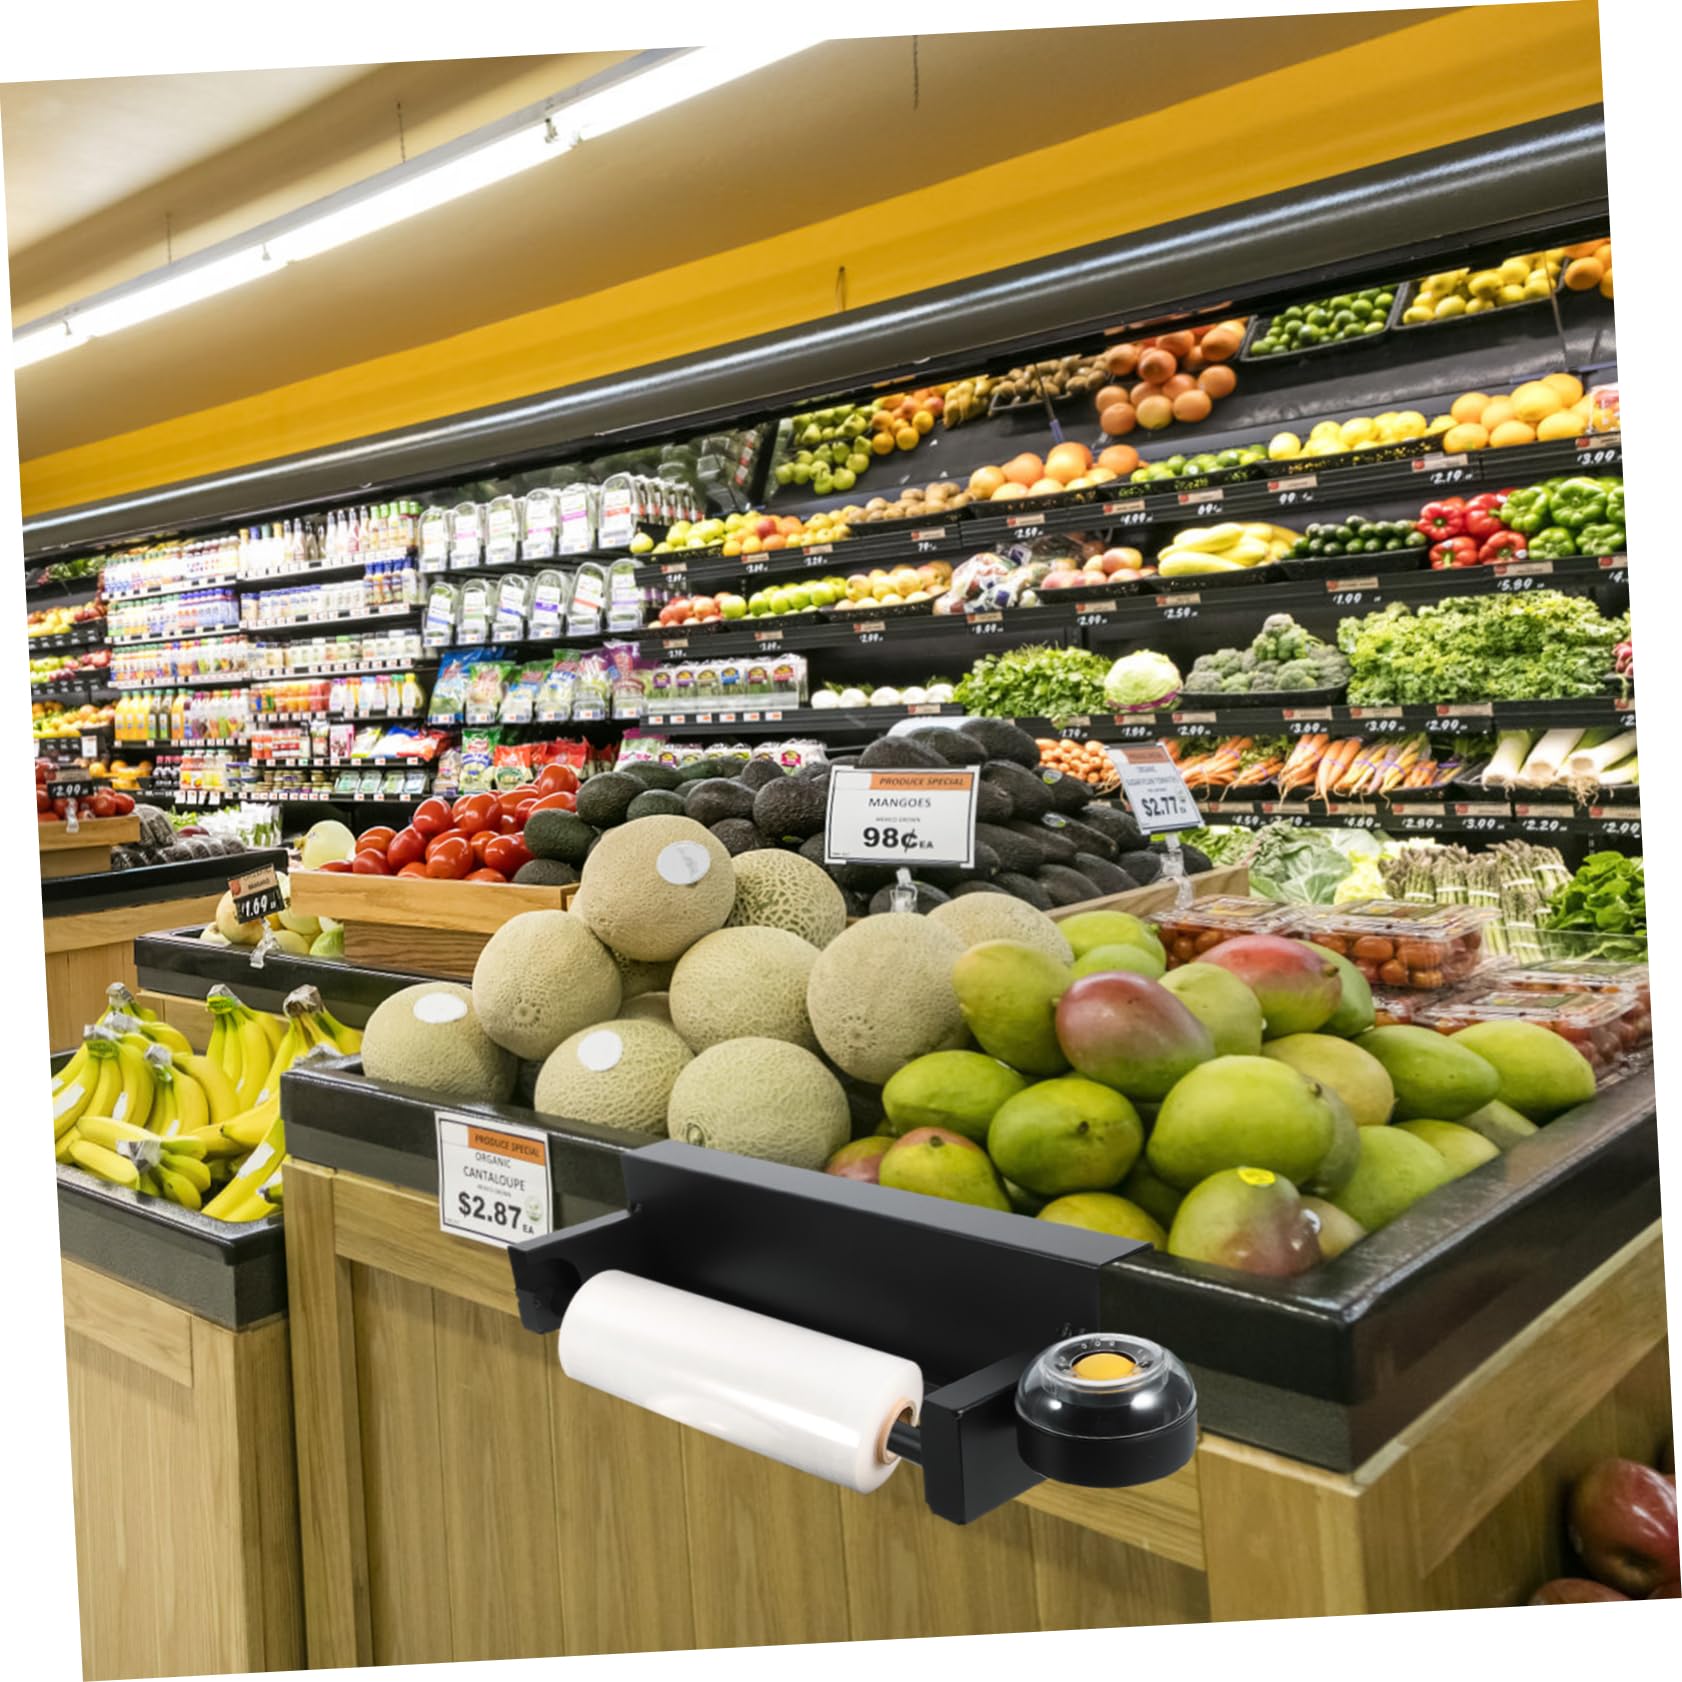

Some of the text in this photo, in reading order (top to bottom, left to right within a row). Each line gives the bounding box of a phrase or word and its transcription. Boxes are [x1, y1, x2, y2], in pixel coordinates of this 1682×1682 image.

[879, 777, 964, 786] PRODUCE SPECIAL
[868, 798, 931, 808] MANGOES
[1142, 796, 1178, 817] $2.77
[863, 827, 935, 853] 98¢ EA
[474, 1134, 540, 1157] PRODUCE SPECIAL
[475, 1151, 511, 1168] ORGANIC
[463, 1165, 526, 1192] CANTALOUPE
[458, 1190, 522, 1229] $2.87
[523, 1224, 534, 1235] EA
